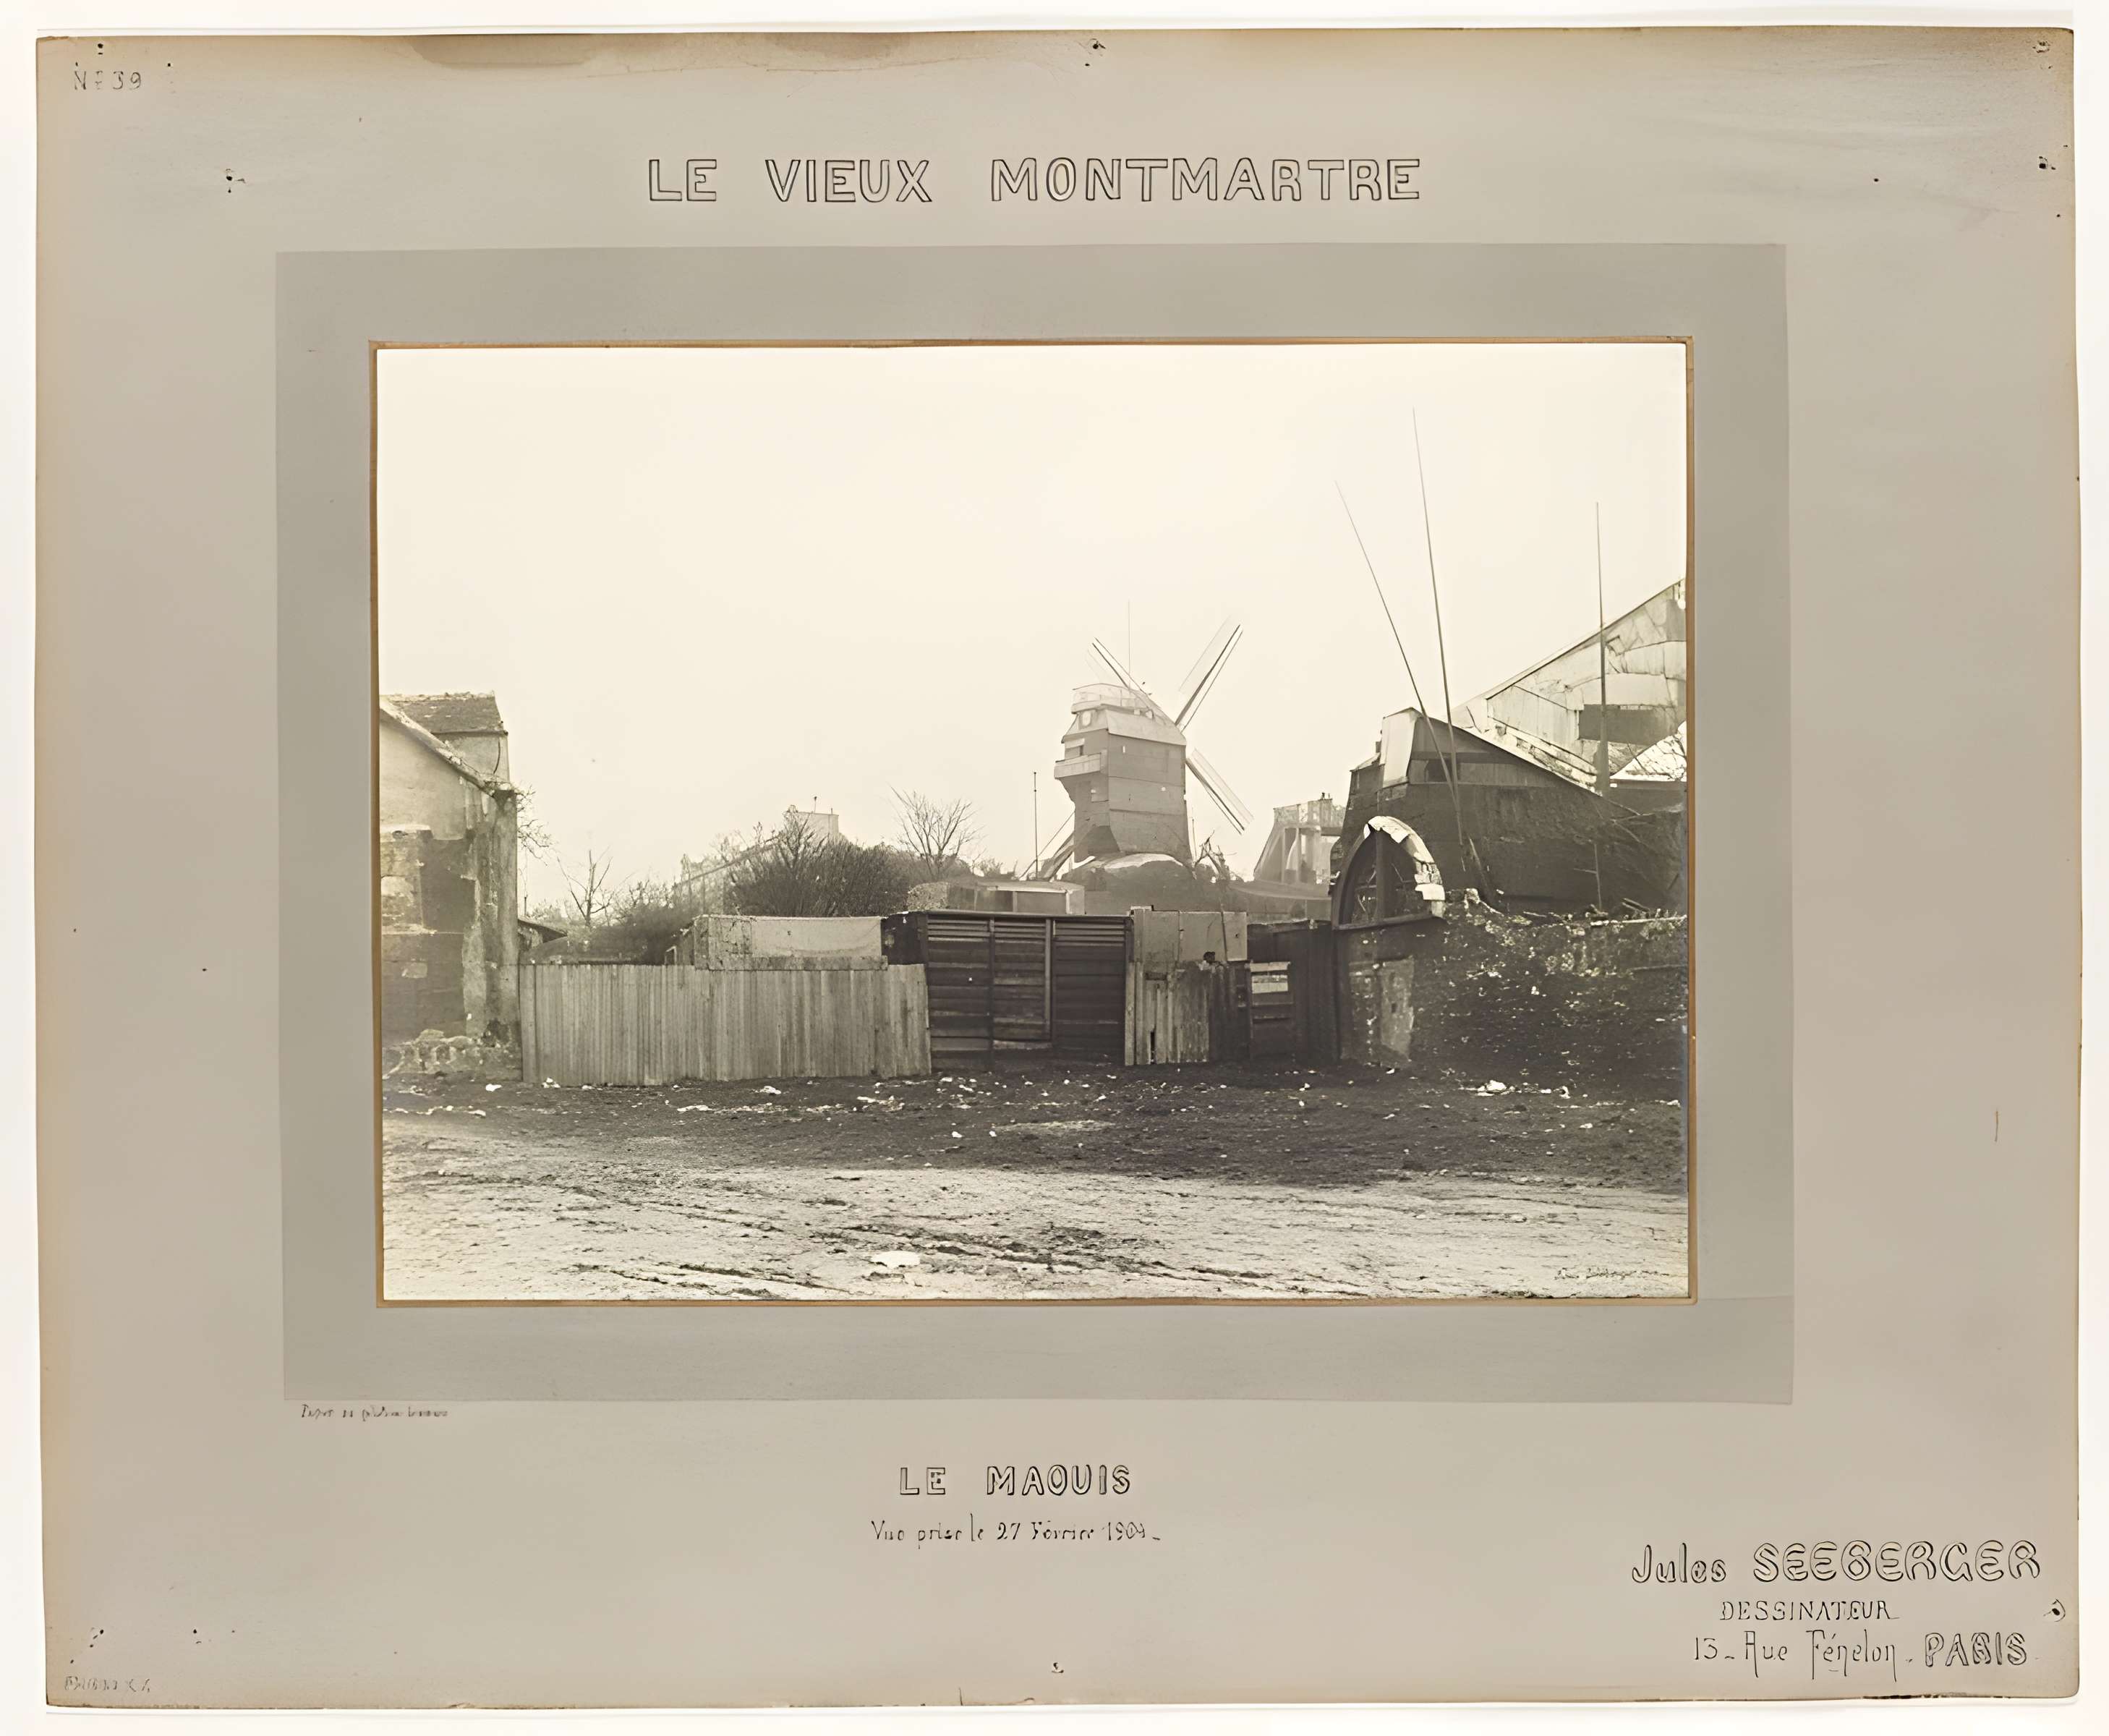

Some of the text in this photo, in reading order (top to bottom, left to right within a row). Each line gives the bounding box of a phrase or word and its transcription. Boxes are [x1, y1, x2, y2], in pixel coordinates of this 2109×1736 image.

[648, 156, 1420, 203] LE VIEUX MONTMARTRE
[899, 1466, 947, 1496] LE
[996, 1521, 1021, 1541] 27
[1631, 1539, 2041, 1584] Jules SEEBERGER
[1719, 1600, 1901, 1621] DESSINATEUR
[1743, 1630, 1788, 1679] Rue
[1805, 1628, 1897, 1683] Fénelon
[1925, 1631, 2027, 1668] PARIS
